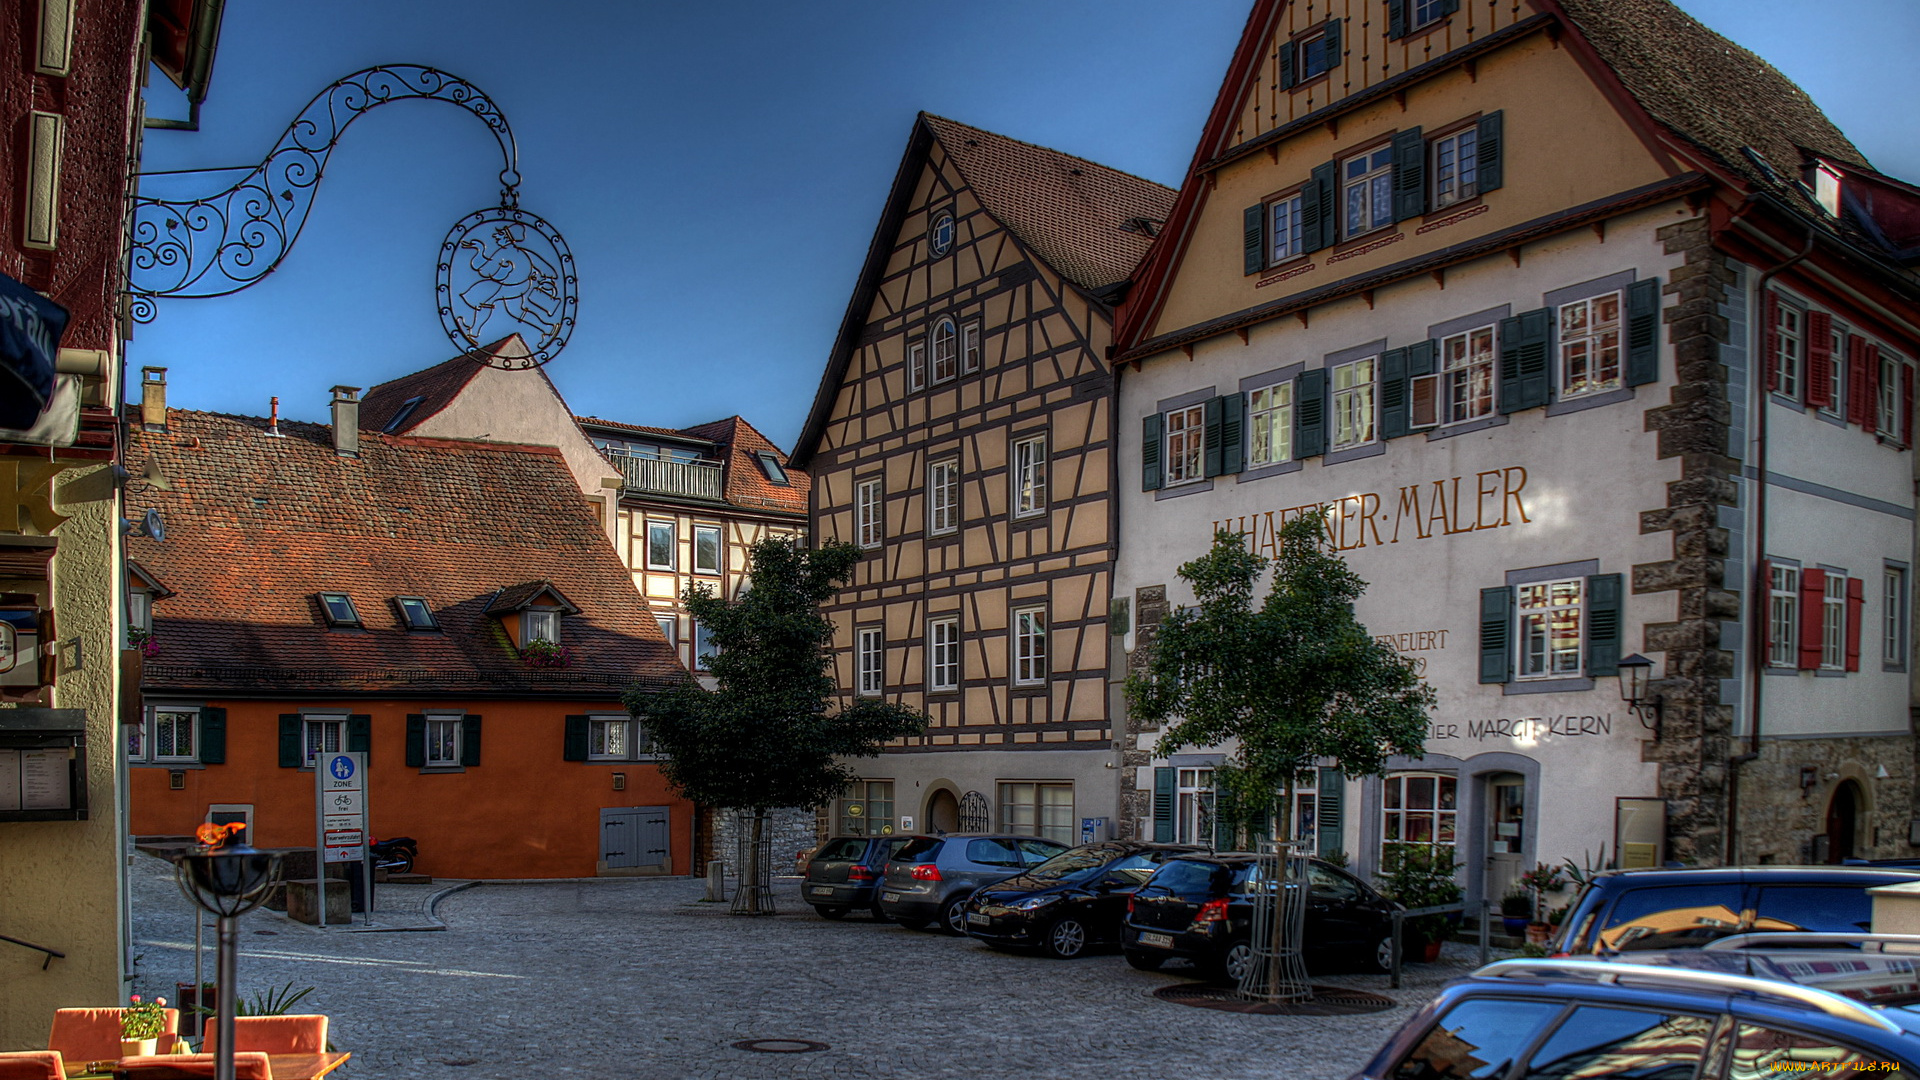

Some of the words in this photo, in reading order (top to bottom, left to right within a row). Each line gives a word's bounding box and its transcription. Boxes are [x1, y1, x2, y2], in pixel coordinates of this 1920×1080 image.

[1390, 465, 1532, 544] MALER
[1467, 717, 1542, 742] MARGIT
[1547, 712, 1611, 737] KERN
[333, 780, 353, 788] ZONE
